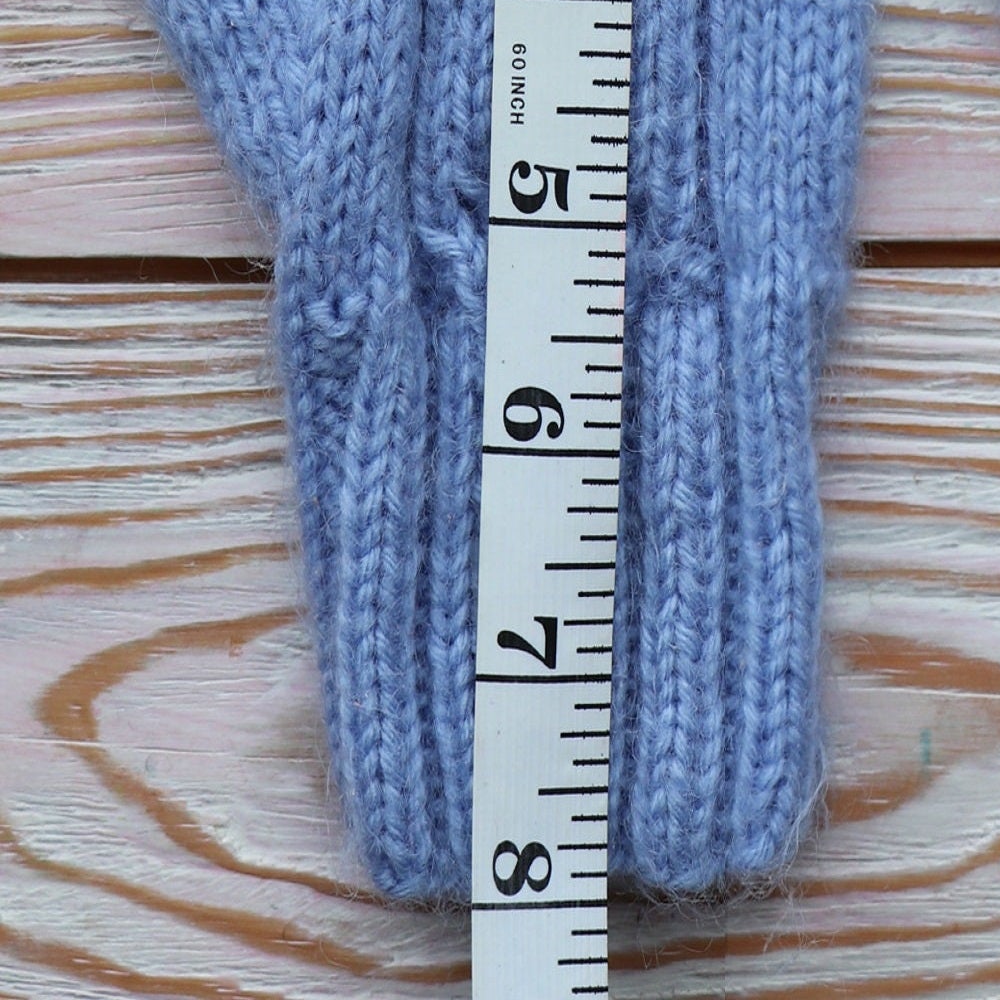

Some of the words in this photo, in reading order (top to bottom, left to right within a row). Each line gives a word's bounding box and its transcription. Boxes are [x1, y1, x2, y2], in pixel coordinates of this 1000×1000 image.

[508, 160, 571, 215] 5
[502, 386, 565, 442] 6
[496, 616, 558, 670] 7
[492, 839, 553, 897] 8
